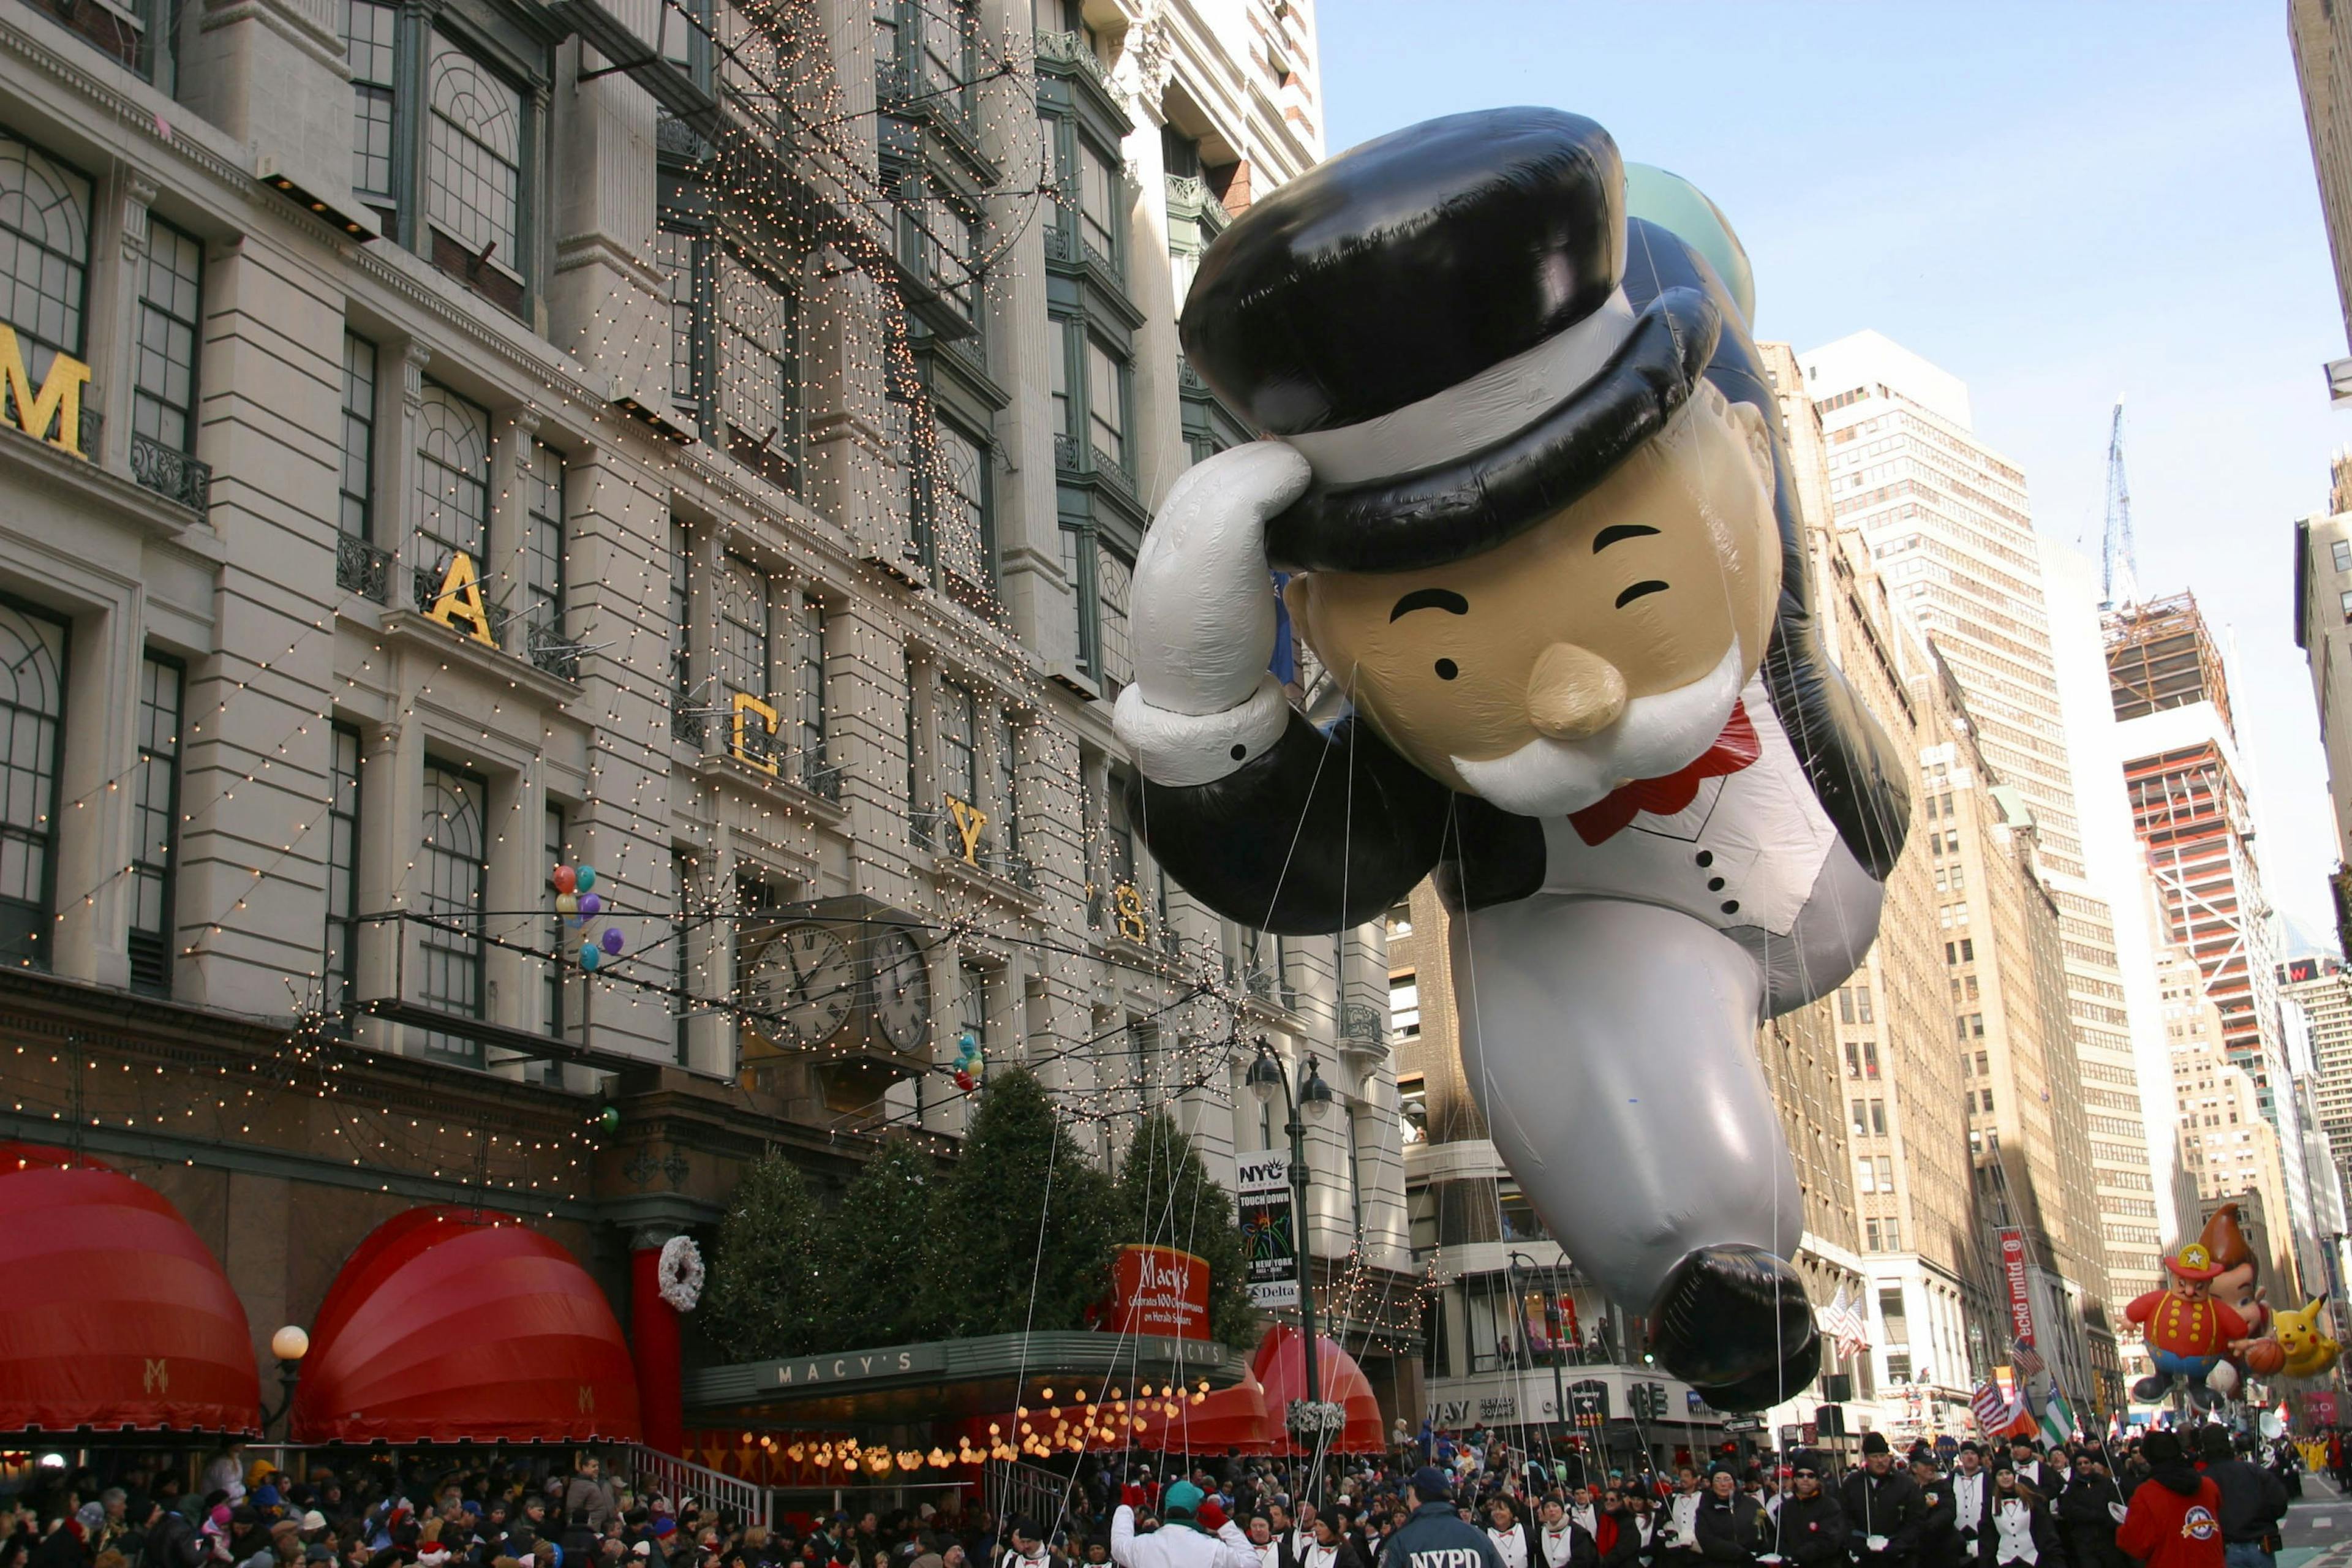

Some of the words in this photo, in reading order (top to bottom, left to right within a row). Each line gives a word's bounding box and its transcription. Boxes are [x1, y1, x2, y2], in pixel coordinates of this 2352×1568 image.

[1240, 1163, 1283, 1183] NYC
[1240, 1194, 1265, 1207] TOUCH
[1266, 1193, 1289, 1204] DOWN
[1255, 1259, 1272, 1269] NEW
[1273, 1257, 1293, 1267] YORK
[1140, 1253, 1189, 1295] Macy's
[1262, 1286, 1294, 1298] Delta
[1157, 1294, 1171, 1308] 100
[1164, 1341, 1219, 1362] MACY'S
[778, 1352, 911, 1384] MACY'S
[1480, 1396, 1515, 1408] HERALD
[1480, 1407, 1515, 1418] SQUARE
[1410, 1548, 1481, 1568] NYPD
